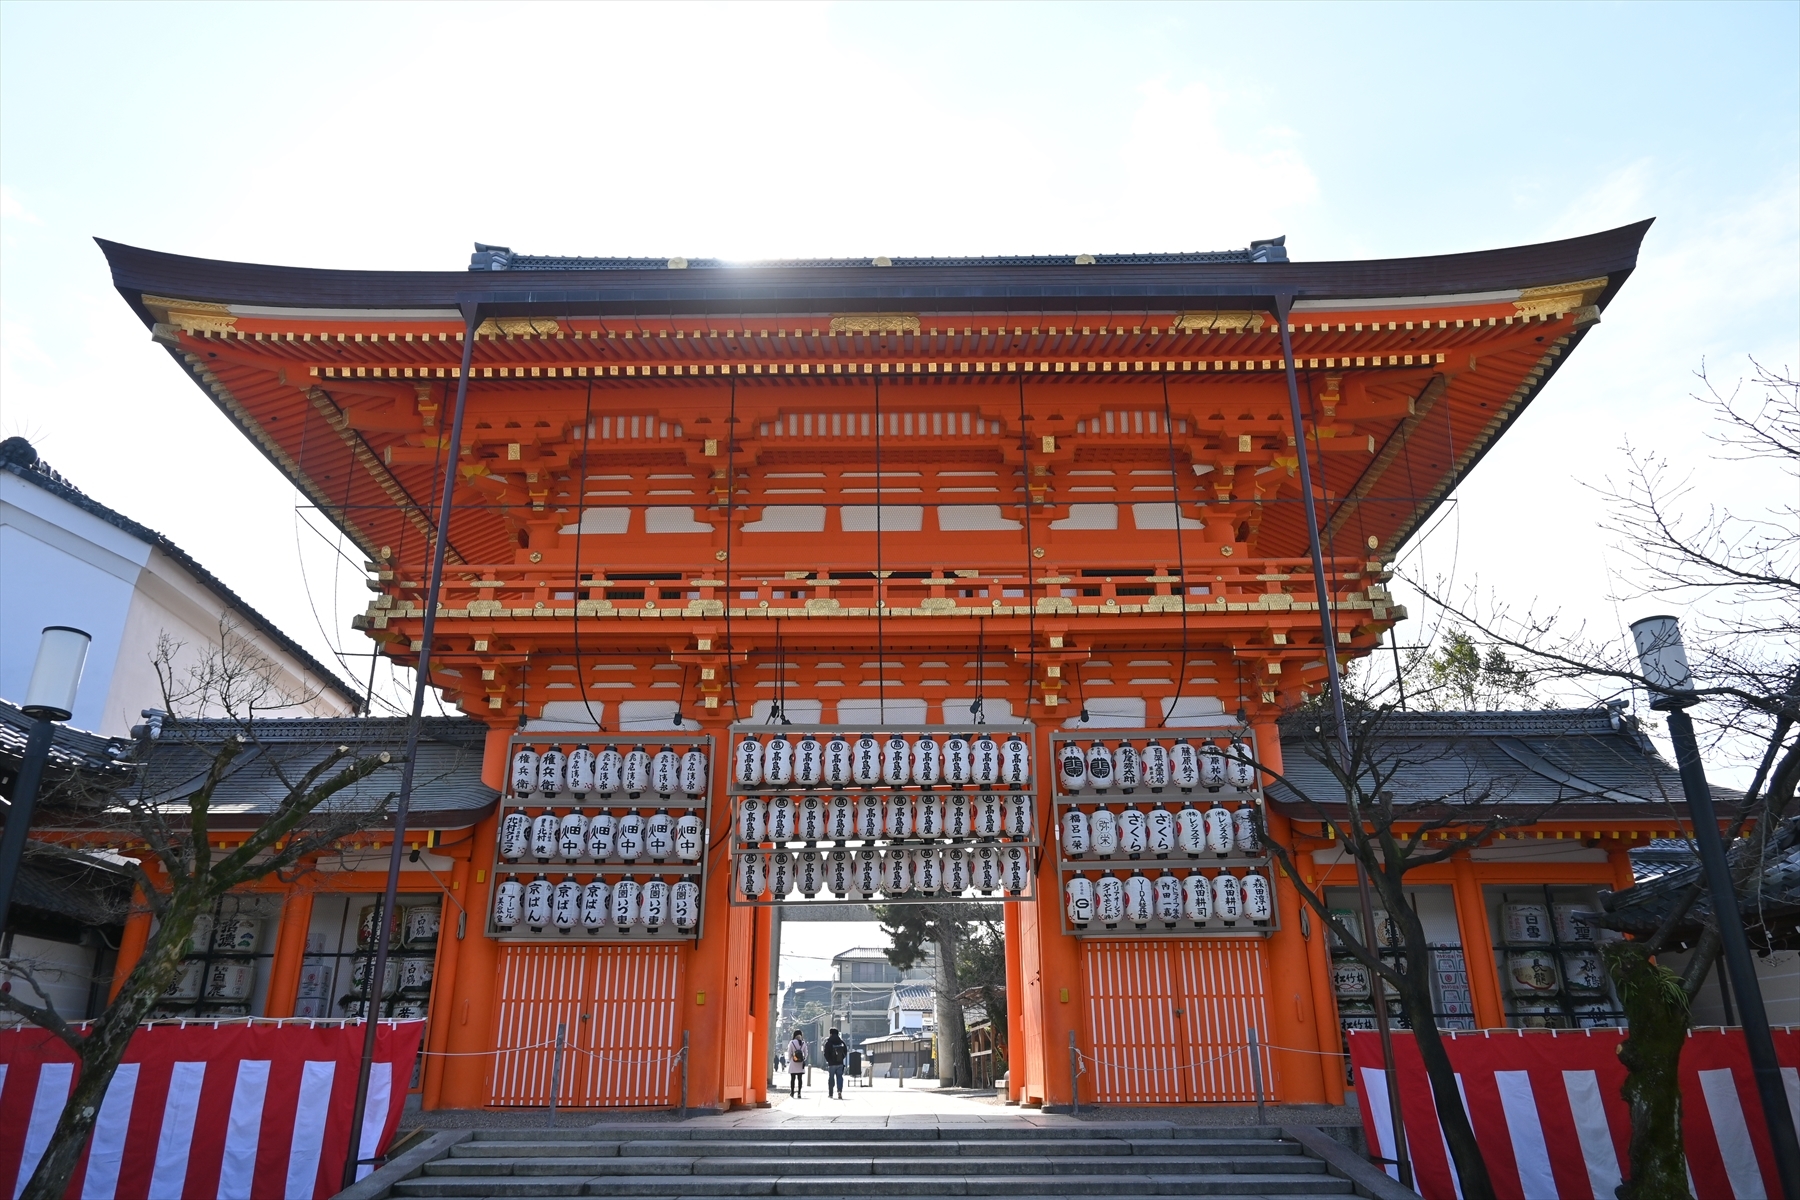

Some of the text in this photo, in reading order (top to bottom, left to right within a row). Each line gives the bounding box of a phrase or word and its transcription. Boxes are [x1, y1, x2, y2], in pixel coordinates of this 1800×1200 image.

[516, 753, 531, 789] 権兵衛
[541, 753, 556, 790] 権兵衛
[561, 825, 581, 855] 畑中
[590, 824, 610, 854] 畑中
[619, 824, 638, 854] 畑中
[648, 824, 667, 853] 畑中
[678, 824, 697, 854] 畑中
[1128, 813, 1142, 852] さくら
[1154, 813, 1169, 850] さくら
[496, 896, 504, 923] 美容室
[505, 895, 515, 919] アービル
[1194, 878, 1207, 918] 森田耕司
[1223, 878, 1236, 916] 森田耕司
[1525, 913, 1541, 938] 白雪
[208, 972, 226, 997] 白鹿
[1334, 972, 1365, 984] 松竹梅
